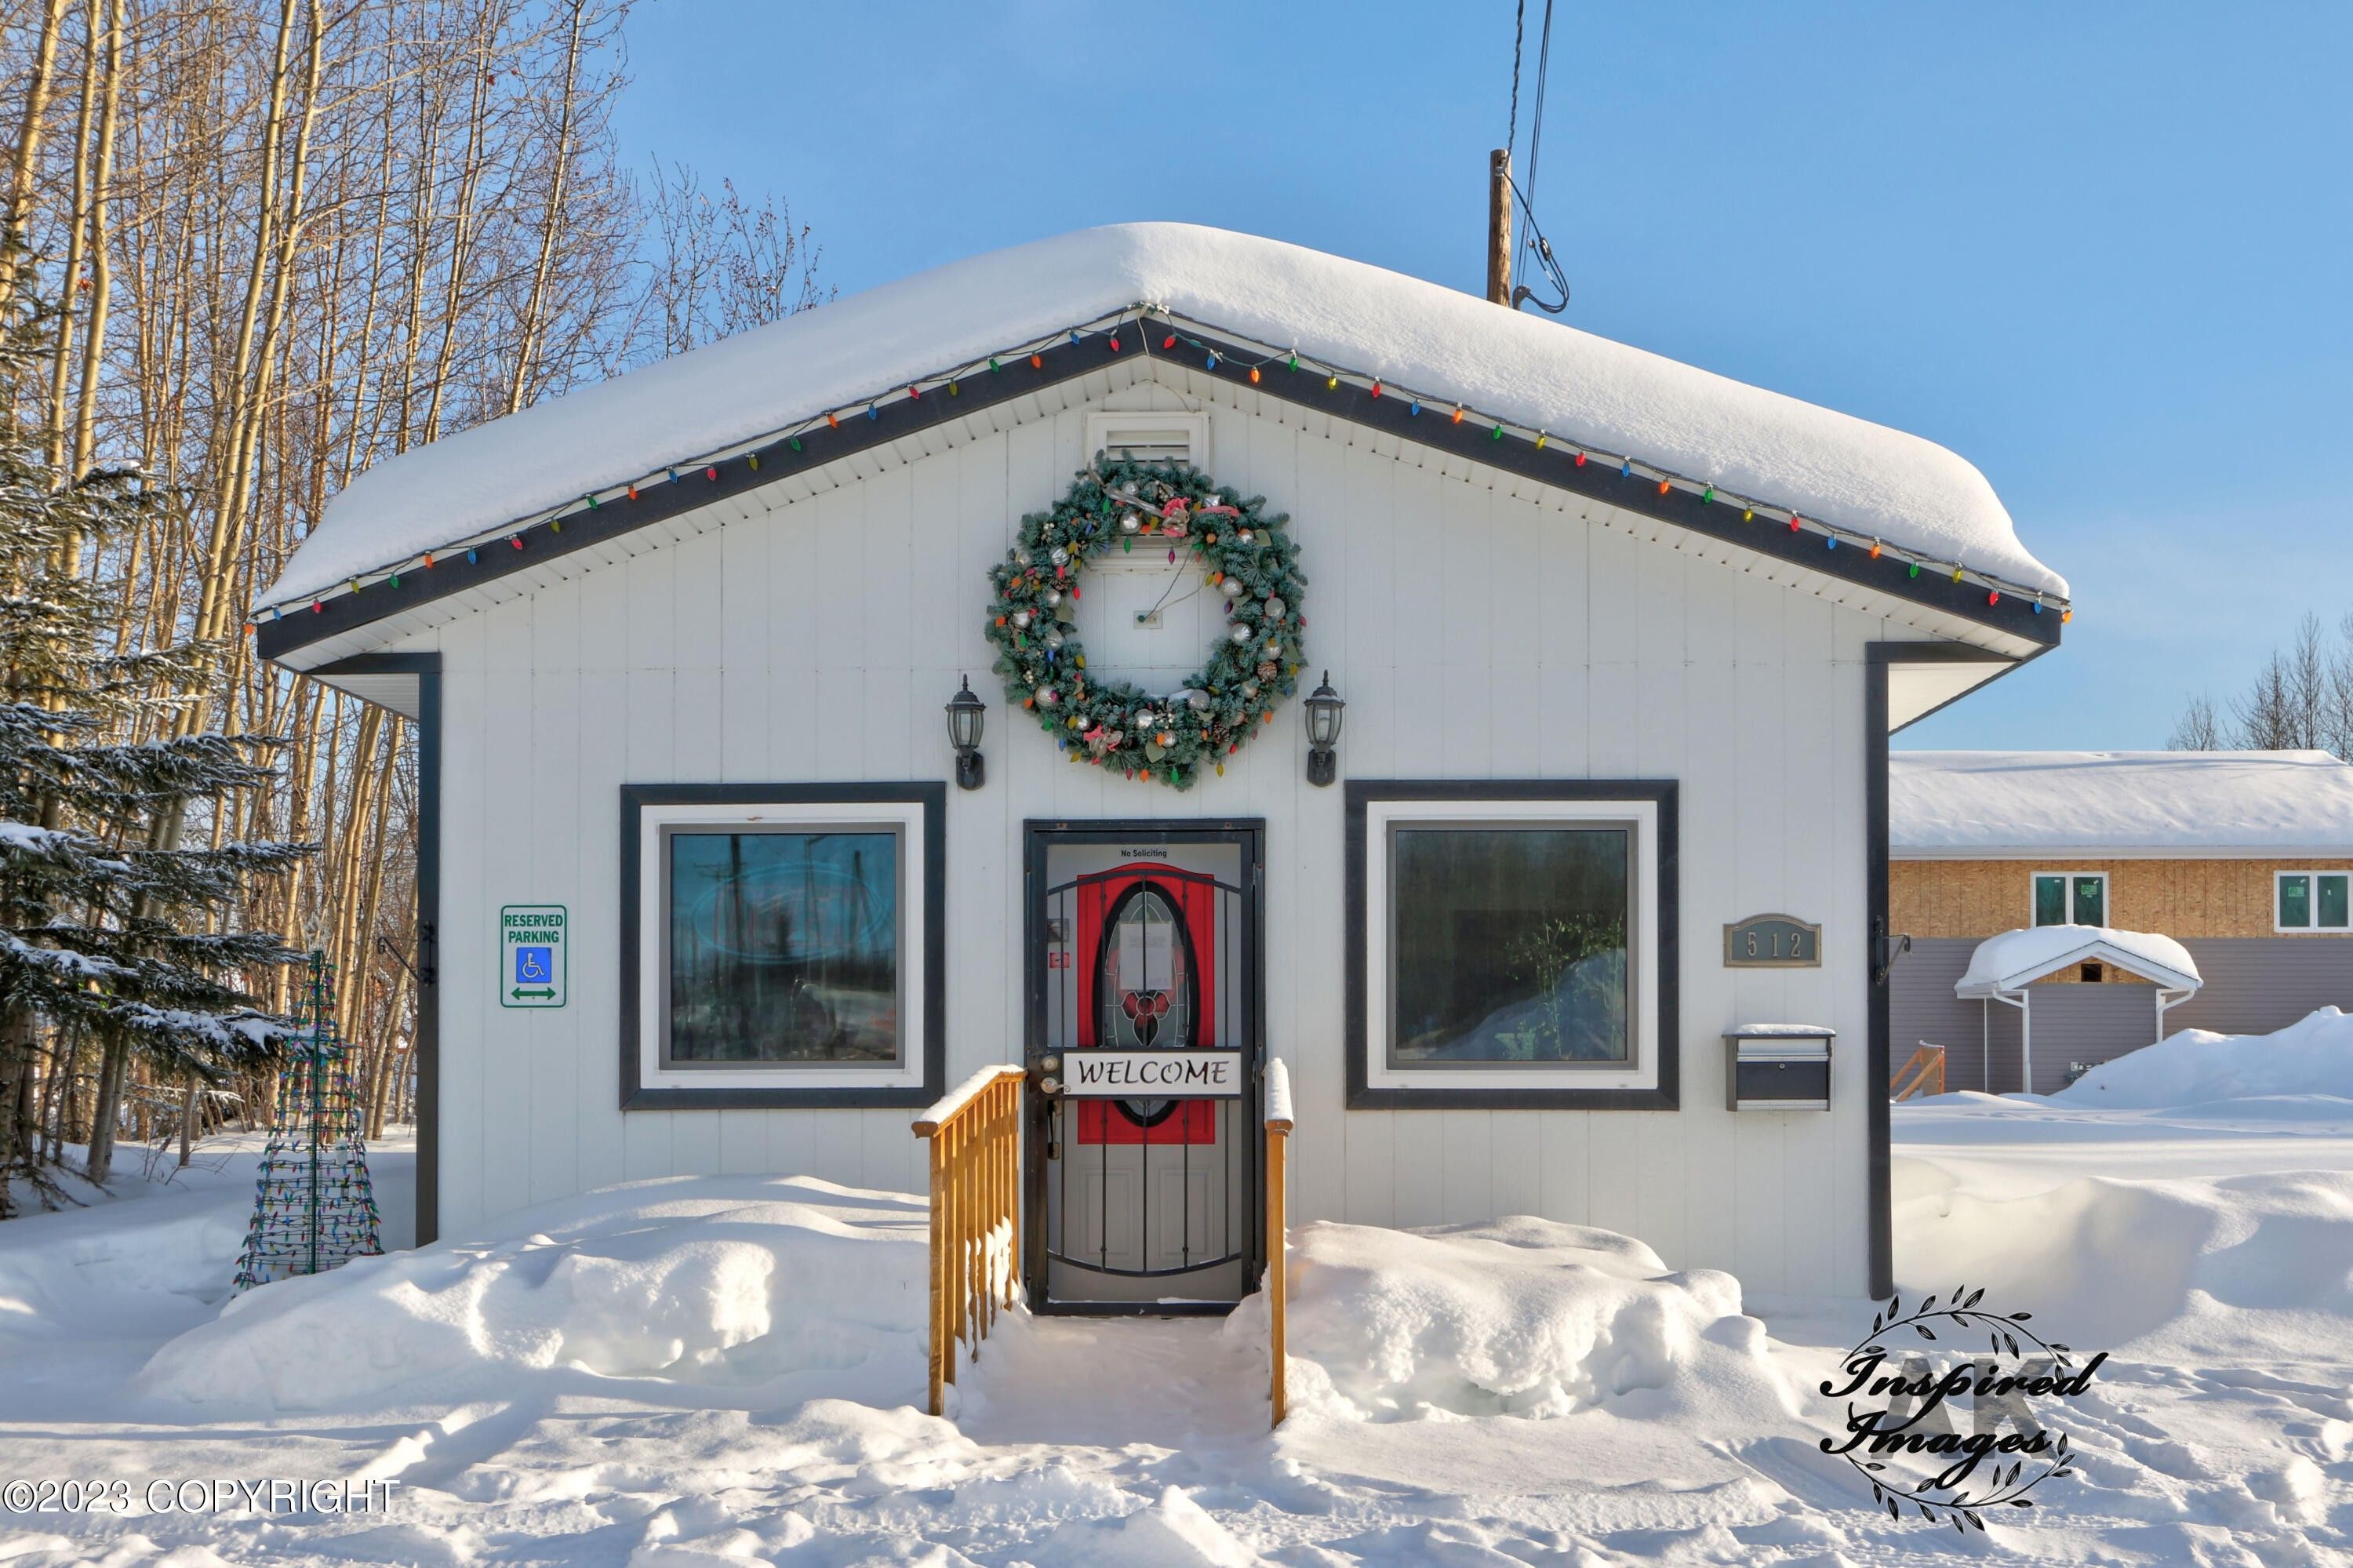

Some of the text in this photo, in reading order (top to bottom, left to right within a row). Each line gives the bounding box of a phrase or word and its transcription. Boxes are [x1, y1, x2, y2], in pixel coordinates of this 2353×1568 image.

[1133, 849, 1167, 859] Soliciting
[504, 915, 563, 927] RESERVED
[508, 930, 559, 943] PARKING
[1747, 932, 1801, 957] 512
[1078, 1059, 1230, 1084] WELCOME
